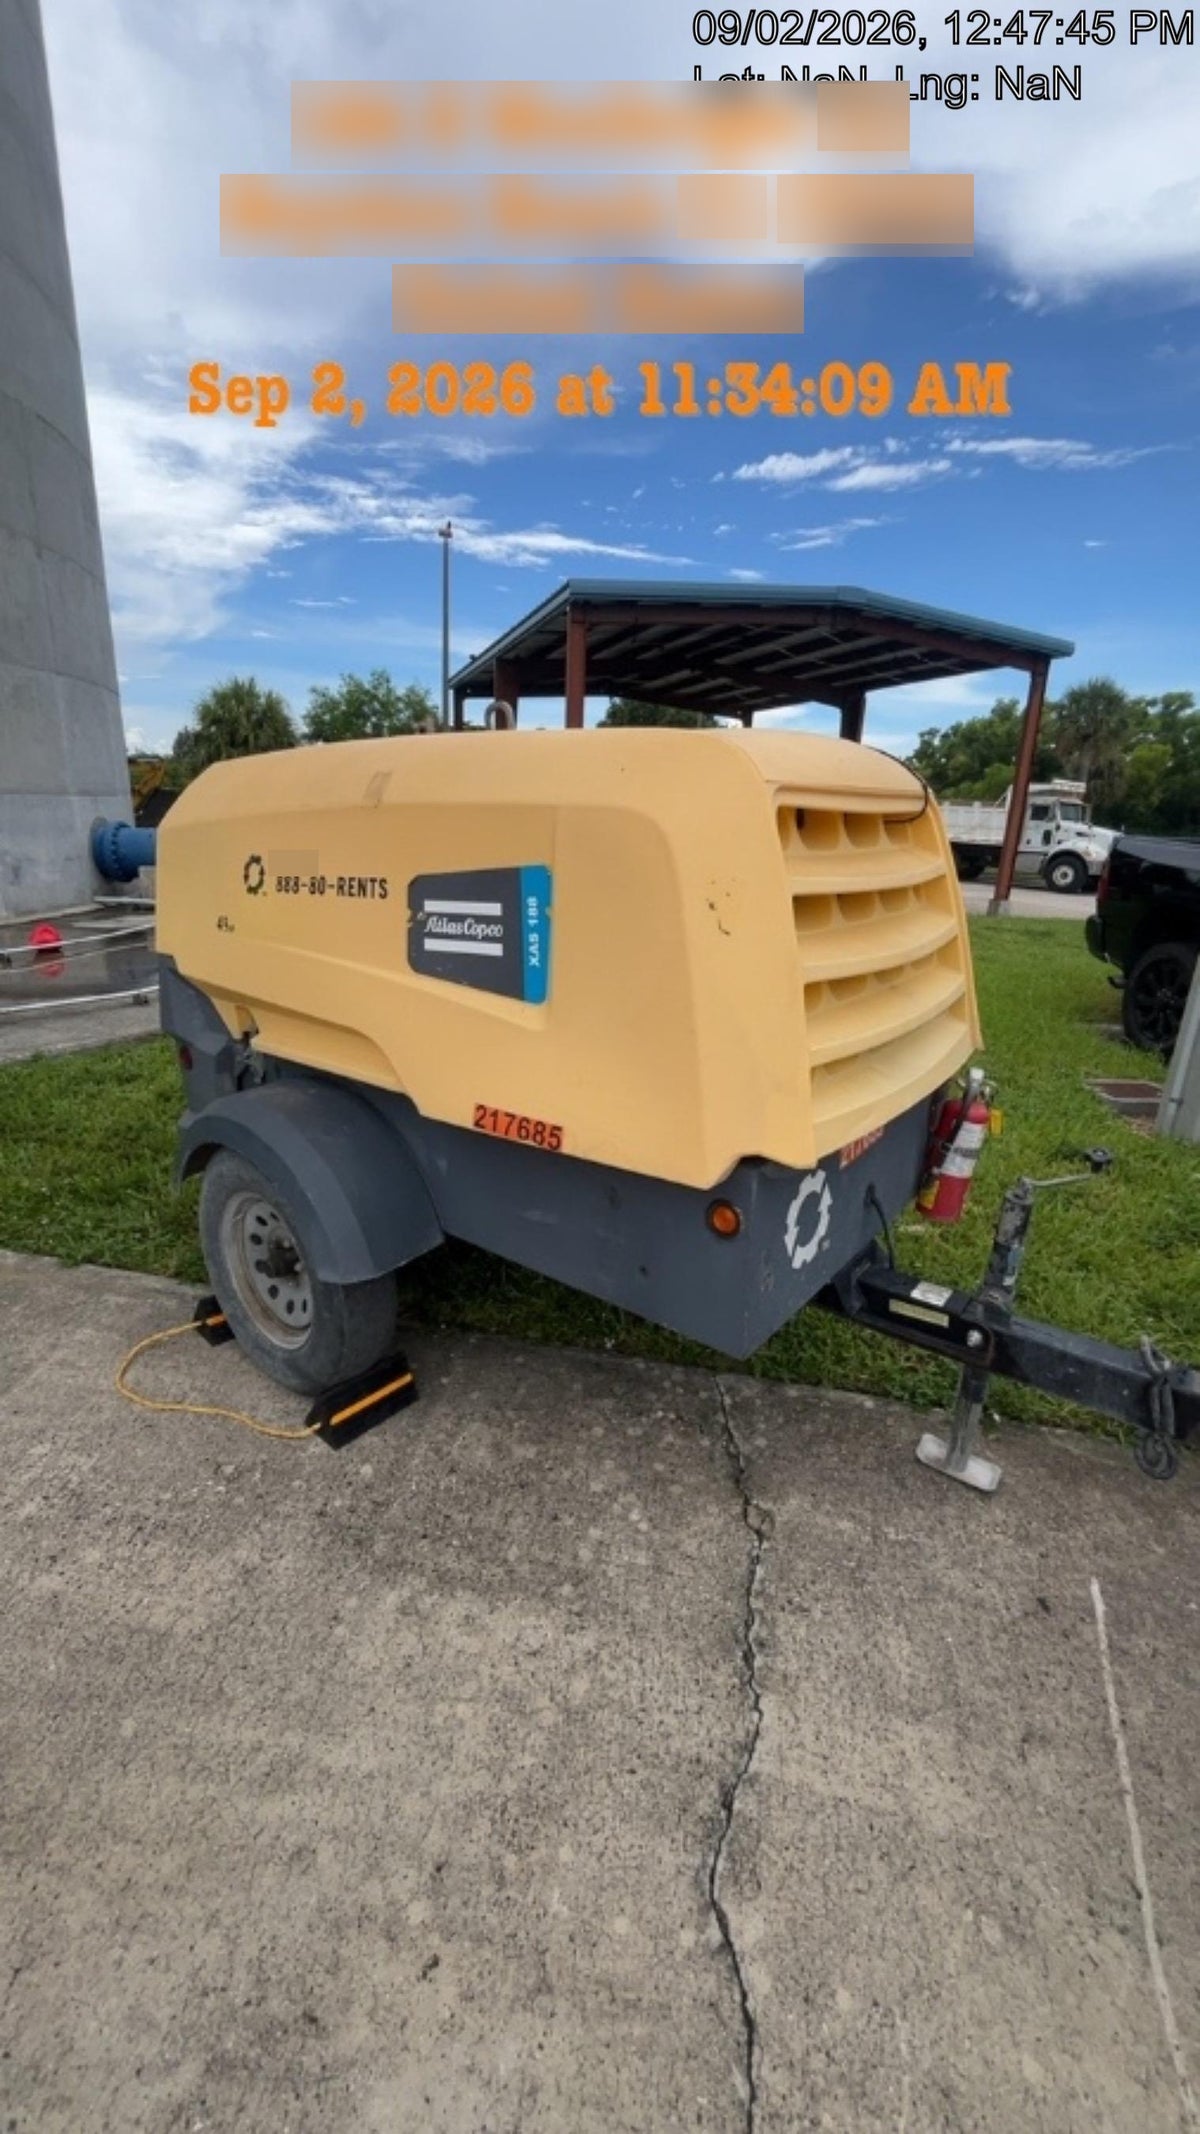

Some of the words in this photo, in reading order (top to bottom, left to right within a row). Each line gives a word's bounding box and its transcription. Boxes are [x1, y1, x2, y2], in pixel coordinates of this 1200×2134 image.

[276, 875, 388, 900] 888-80-RENTS
[527, 896, 539, 928] 188
[528, 933, 540, 967] XAS
[473, 1103, 564, 1151] 217685
